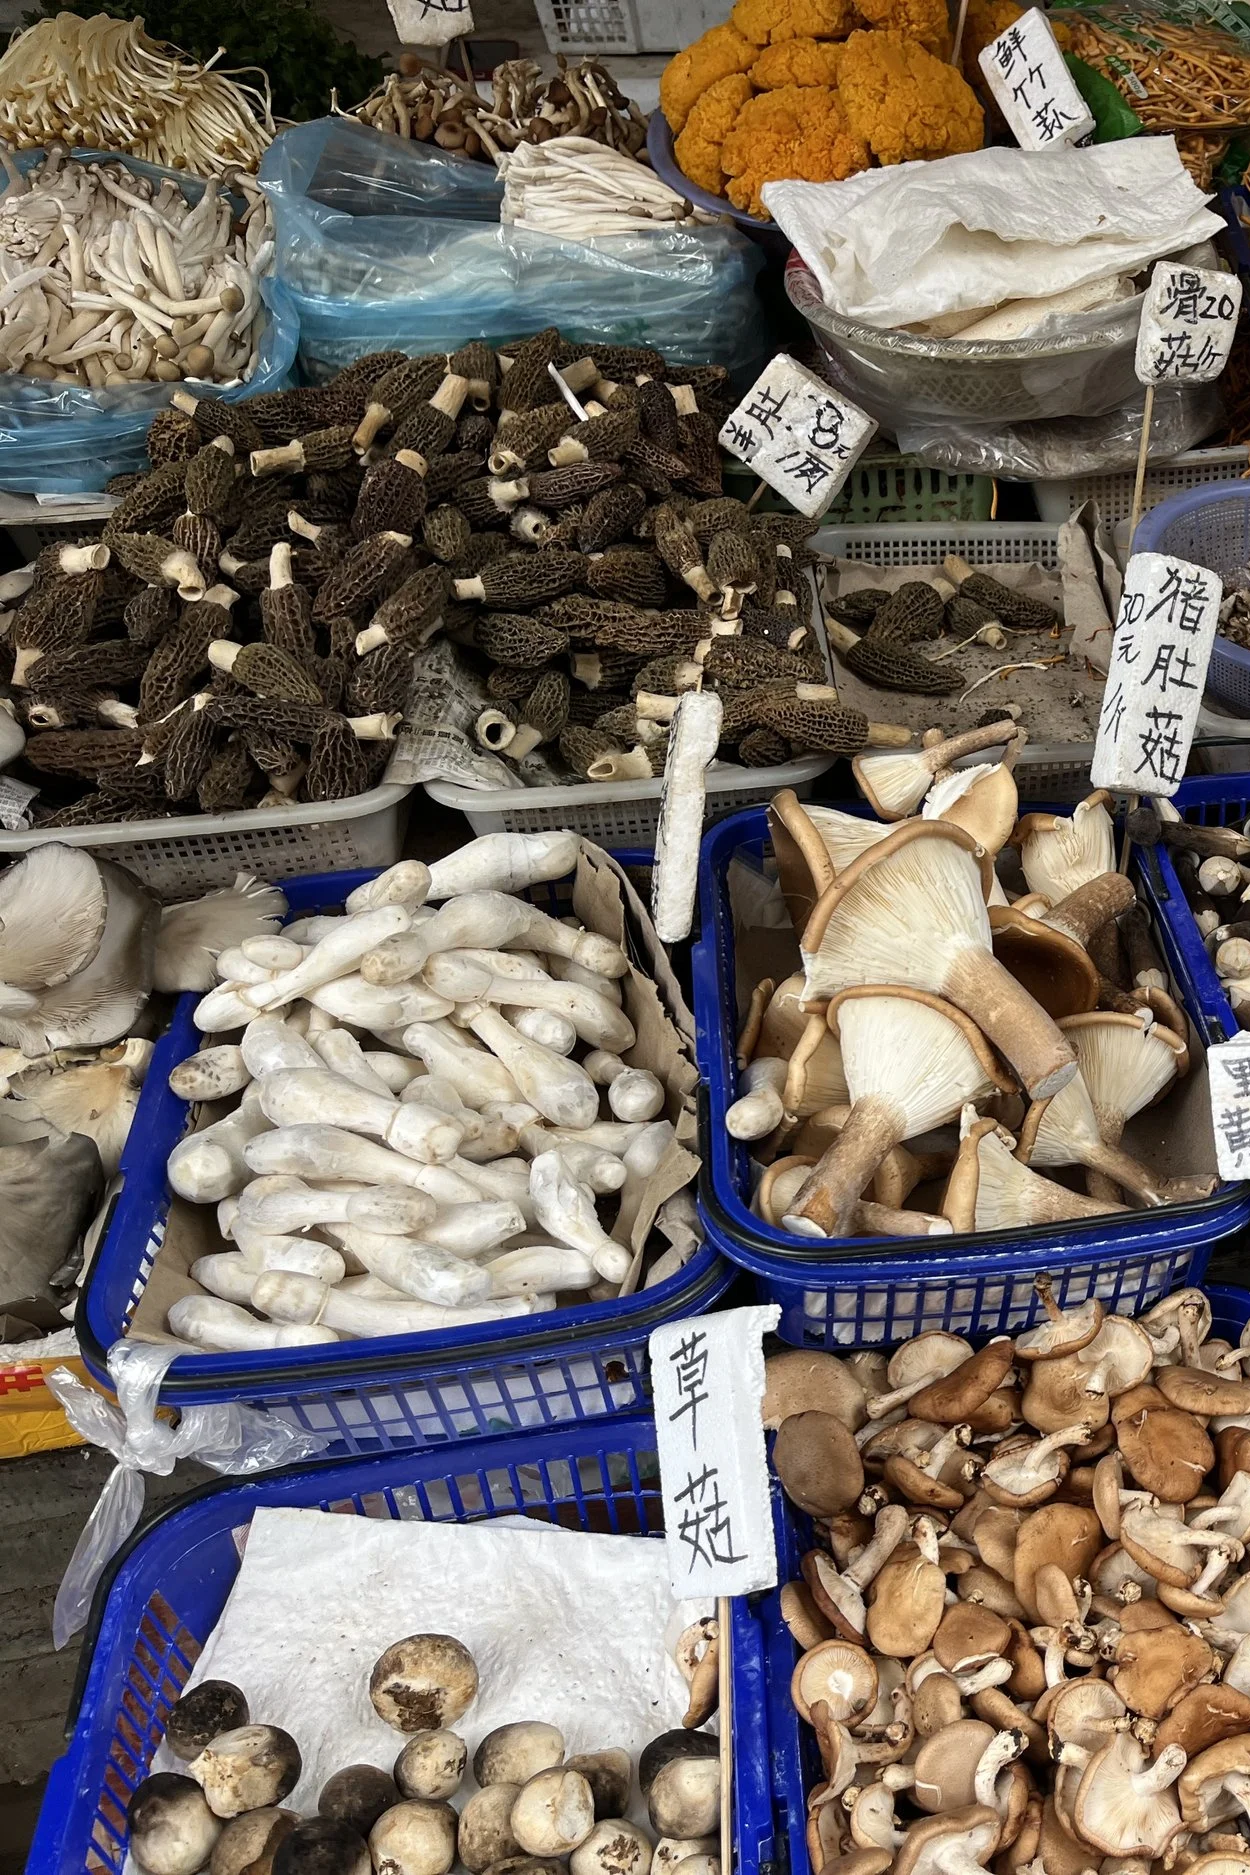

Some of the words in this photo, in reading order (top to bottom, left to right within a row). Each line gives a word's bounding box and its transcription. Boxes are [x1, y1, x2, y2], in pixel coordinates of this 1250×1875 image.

[1134, 567, 1209, 784] 猪肚菇
[669, 1331, 748, 1575] 草菇
